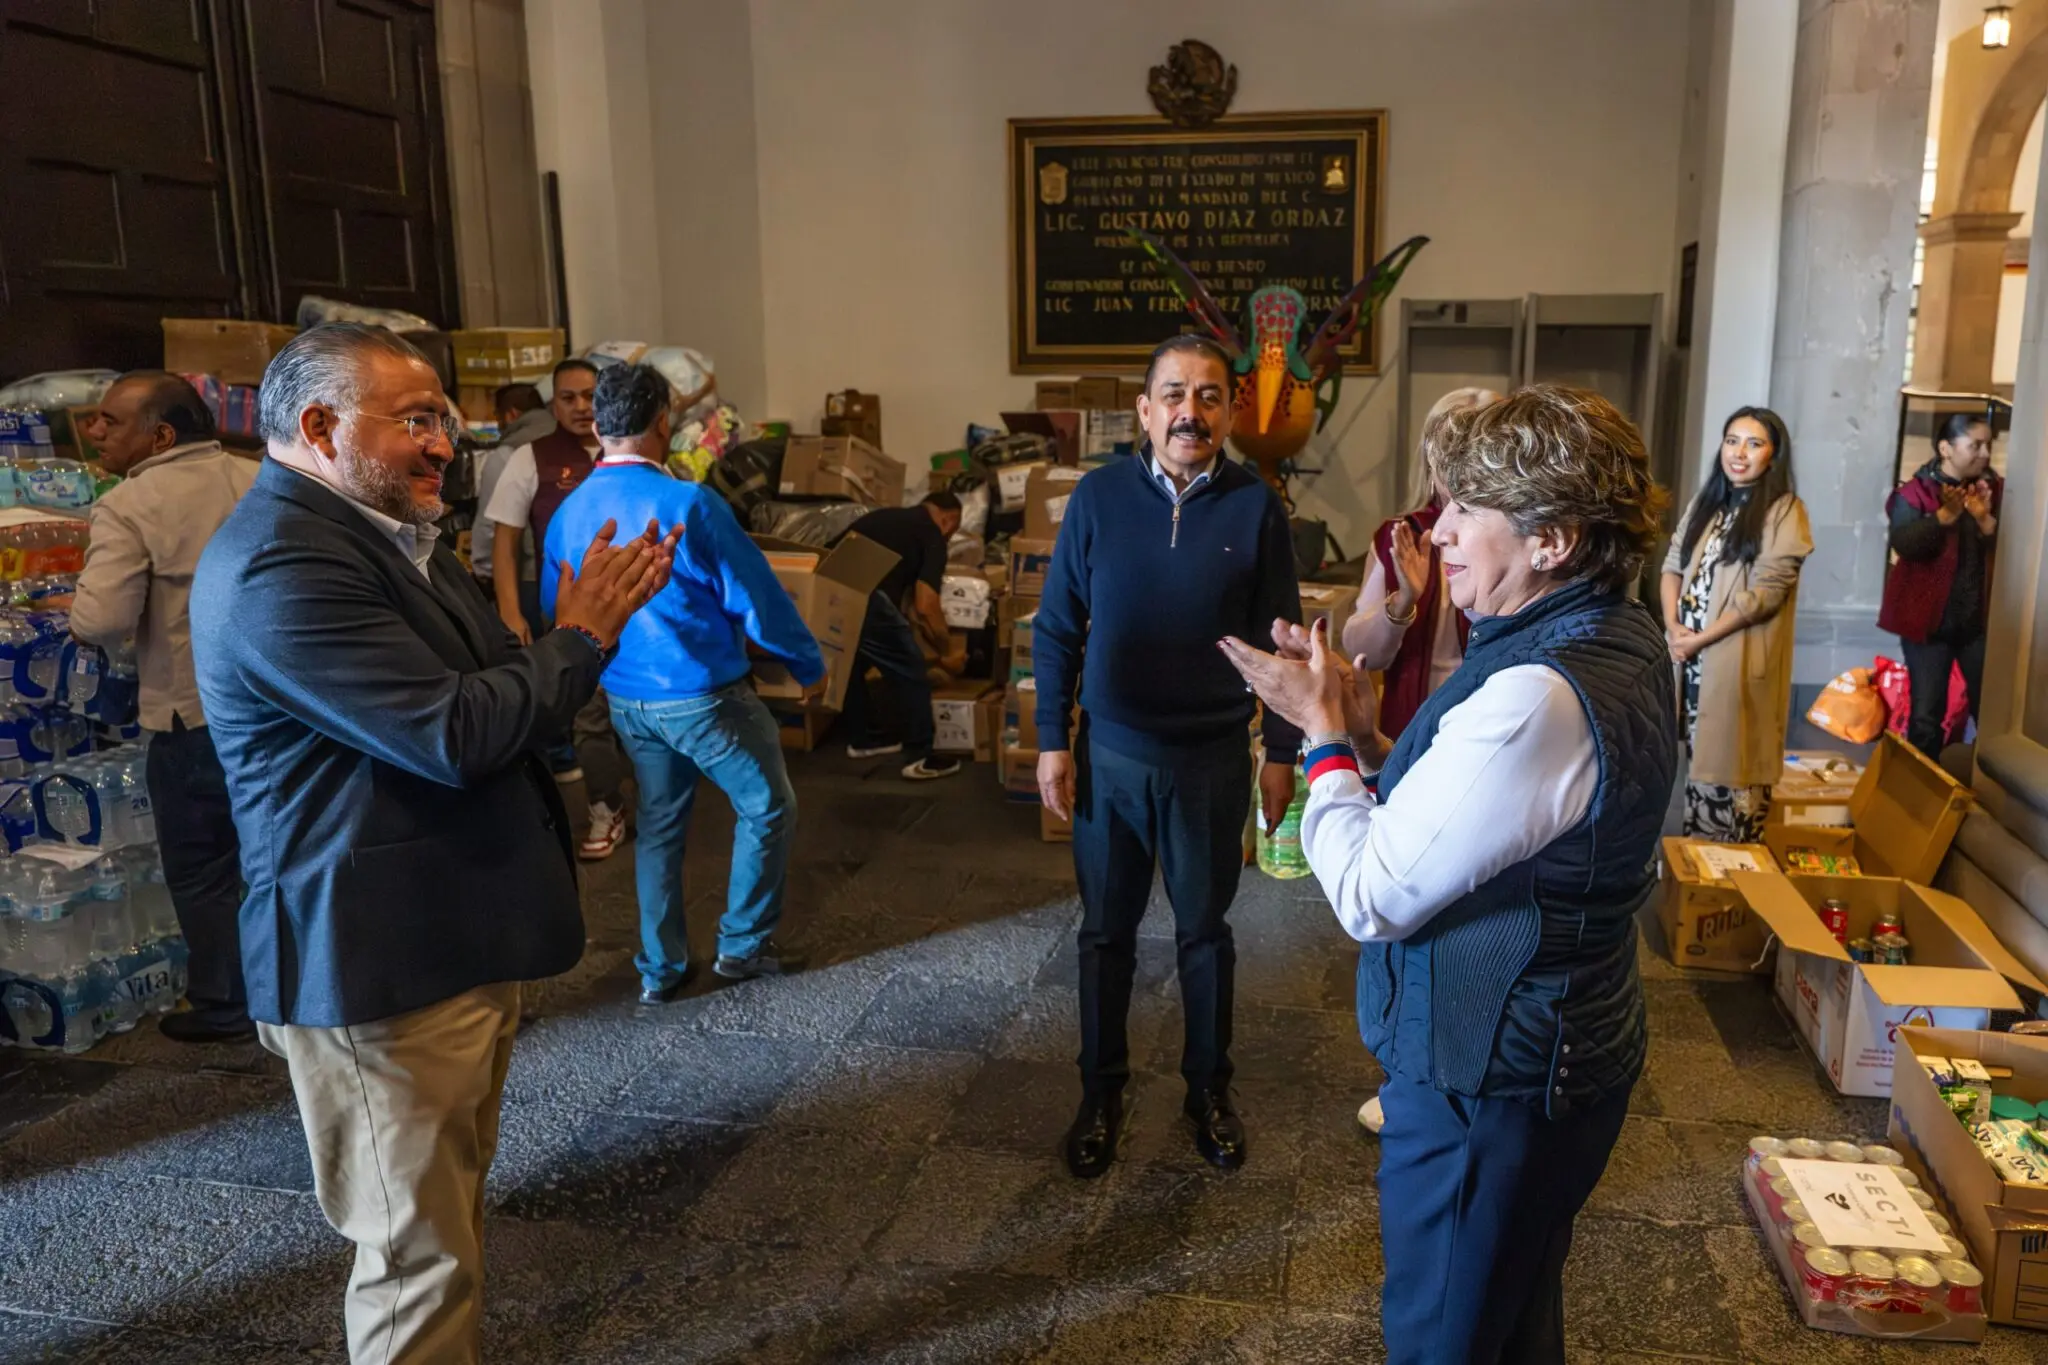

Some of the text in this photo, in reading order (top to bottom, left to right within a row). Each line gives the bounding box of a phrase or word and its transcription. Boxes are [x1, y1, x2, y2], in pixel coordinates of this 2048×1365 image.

[1100, 210, 1190, 229] GUSTAVO
[1204, 209, 1256, 229] DIAZ
[1270, 207, 1346, 228] ORDAZ
[1855, 1172, 1916, 1237] SECTI
